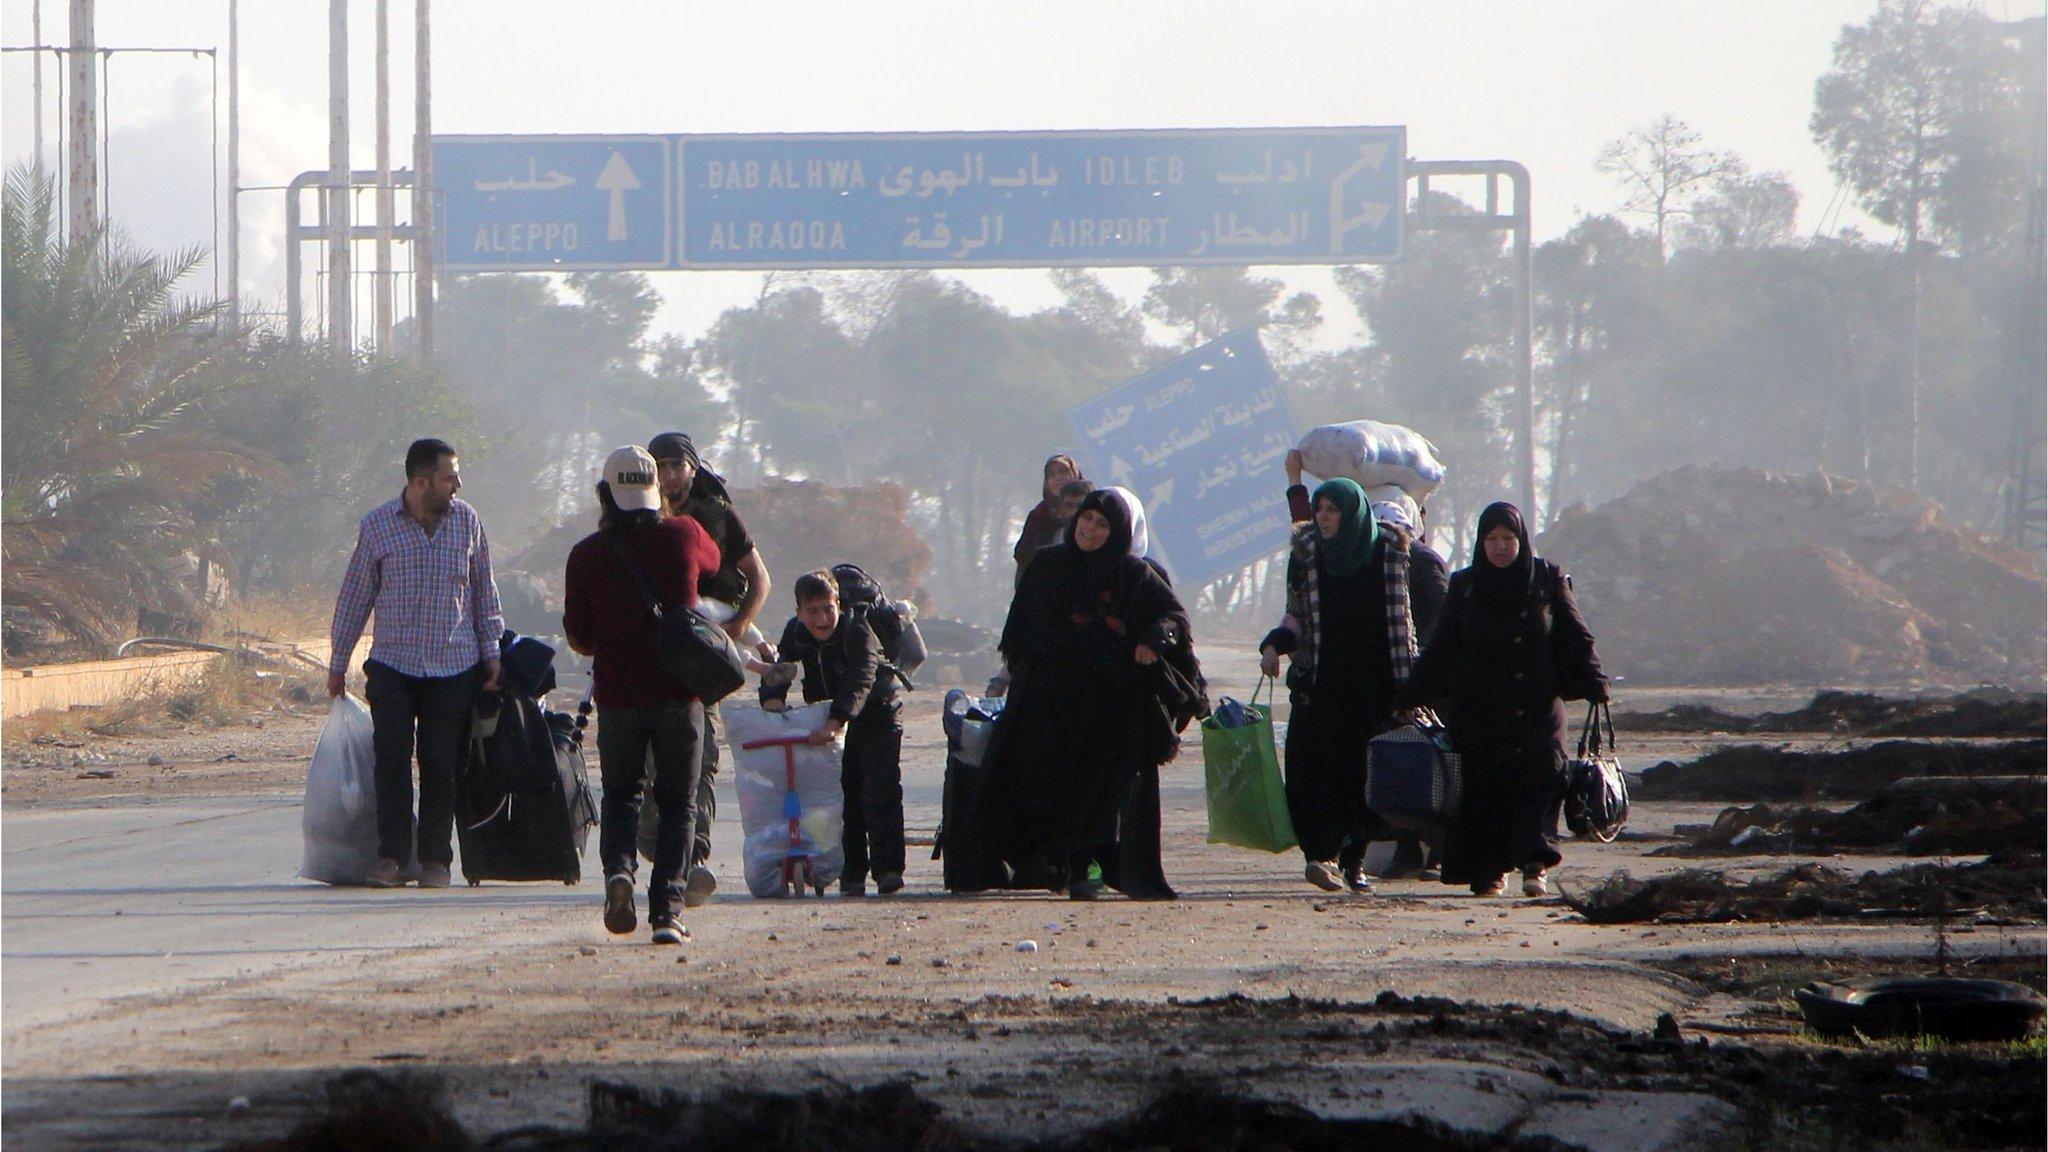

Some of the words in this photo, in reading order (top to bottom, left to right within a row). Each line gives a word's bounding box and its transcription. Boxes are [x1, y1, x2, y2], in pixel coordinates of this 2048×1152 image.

[475, 157, 577, 202] حلب
[708, 161, 759, 190] BAB
[987, 153, 1058, 197] باب
[1085, 155, 1184, 186] IDLEB
[474, 222, 578, 252] ALEPPO
[709, 221, 846, 251] ALRAQQA
[902, 212, 1004, 259] الرقة
[1049, 217, 1170, 248] AIRPORT
[1186, 209, 1308, 255] المطار
[1085, 404, 1135, 445] حلب
